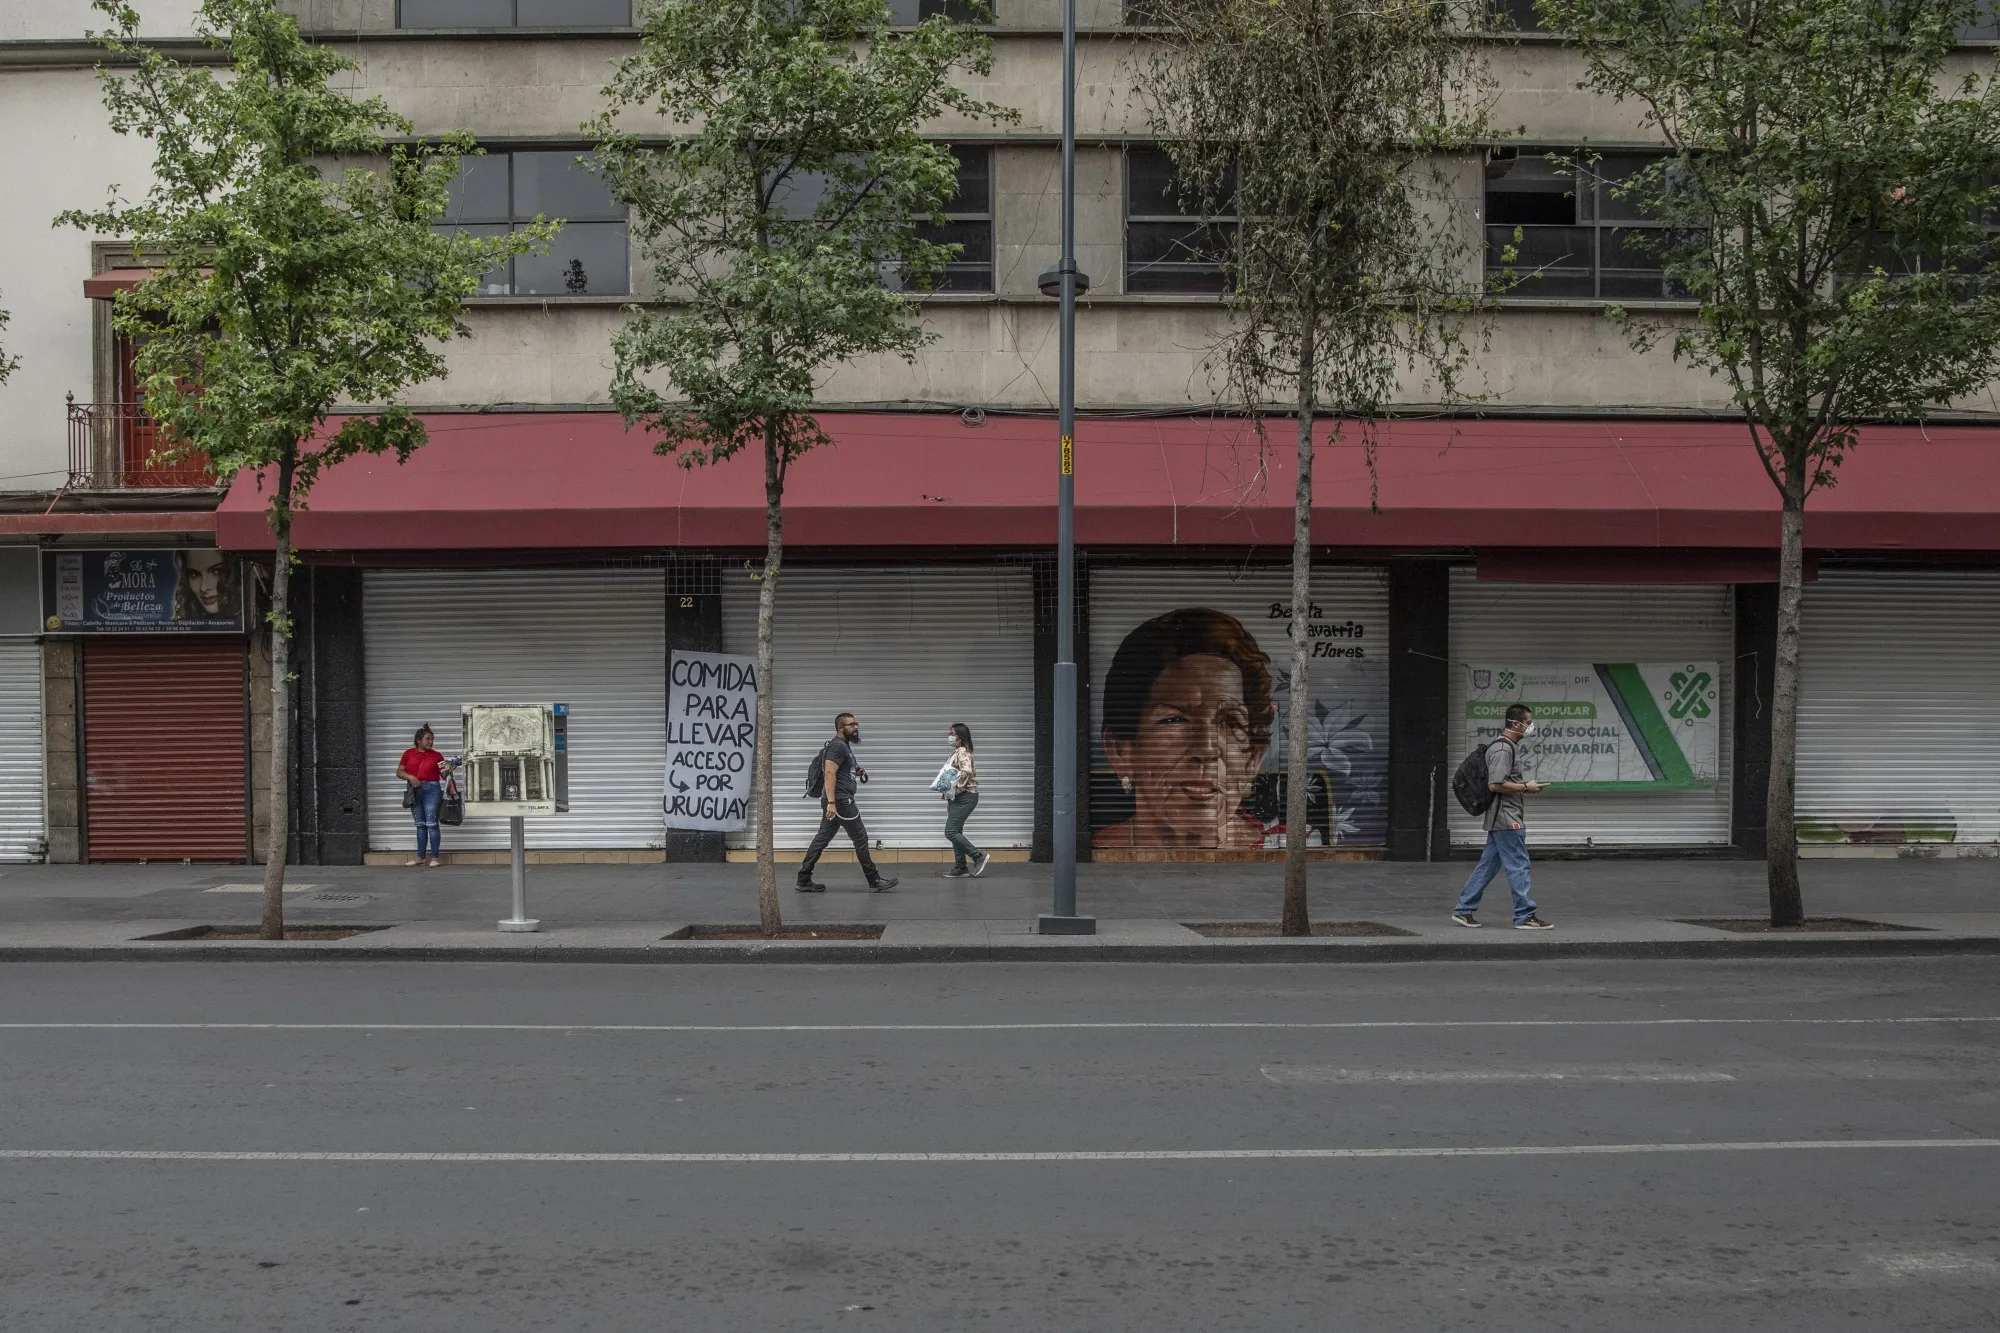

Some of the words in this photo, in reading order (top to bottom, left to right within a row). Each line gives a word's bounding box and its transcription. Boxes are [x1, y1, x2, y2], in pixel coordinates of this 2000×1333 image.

[122, 572, 156, 588] MORA
[106, 592, 155, 601] Productos
[680, 597, 694, 608] 22
[123, 601, 161, 611] Belleza
[1266, 602, 1323, 618] Beta
[1286, 620, 1364, 638] Cavarria
[1311, 641, 1364, 658] Flores
[671, 659, 757, 693] COMIDA
[1574, 676, 1590, 685] DIF
[685, 693, 749, 722] PARA
[1474, 706, 1507, 716] COME
[1535, 706, 1590, 716] POPULAR
[667, 721, 754, 748] LLEVAR
[1567, 726, 1620, 738] SOCIAL
[672, 751, 744, 773] ACCESO
[695, 773, 734, 792] POR
[663, 795, 750, 821] URUGUAY
